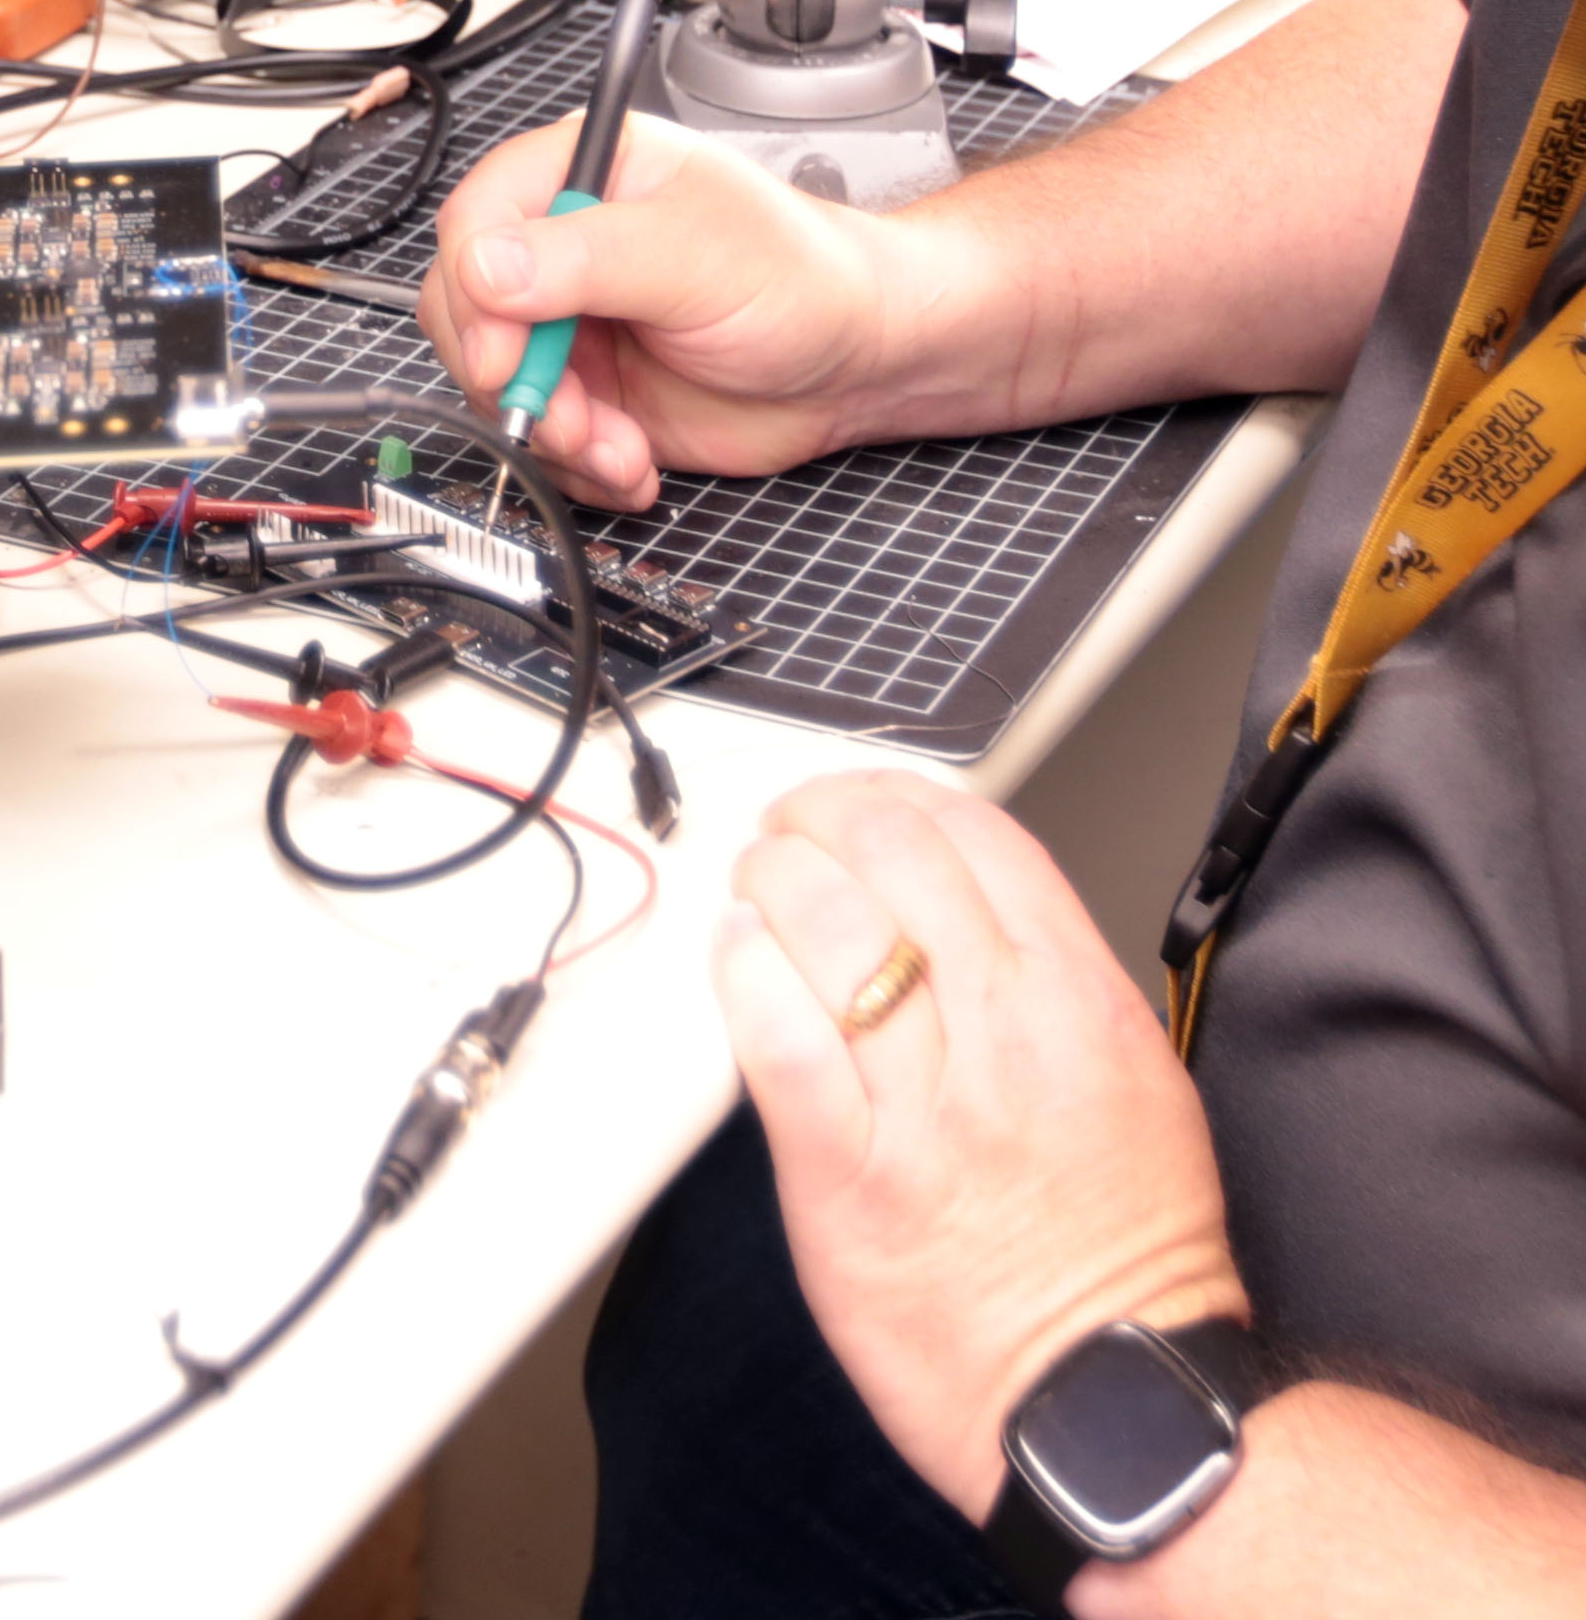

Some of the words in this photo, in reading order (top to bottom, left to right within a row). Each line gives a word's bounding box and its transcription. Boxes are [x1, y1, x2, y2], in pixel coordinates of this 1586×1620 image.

[1513, 99, 1580, 221] TECH
[1415, 388, 1544, 509] GEORGIA
[1461, 431, 1552, 513] TECH
